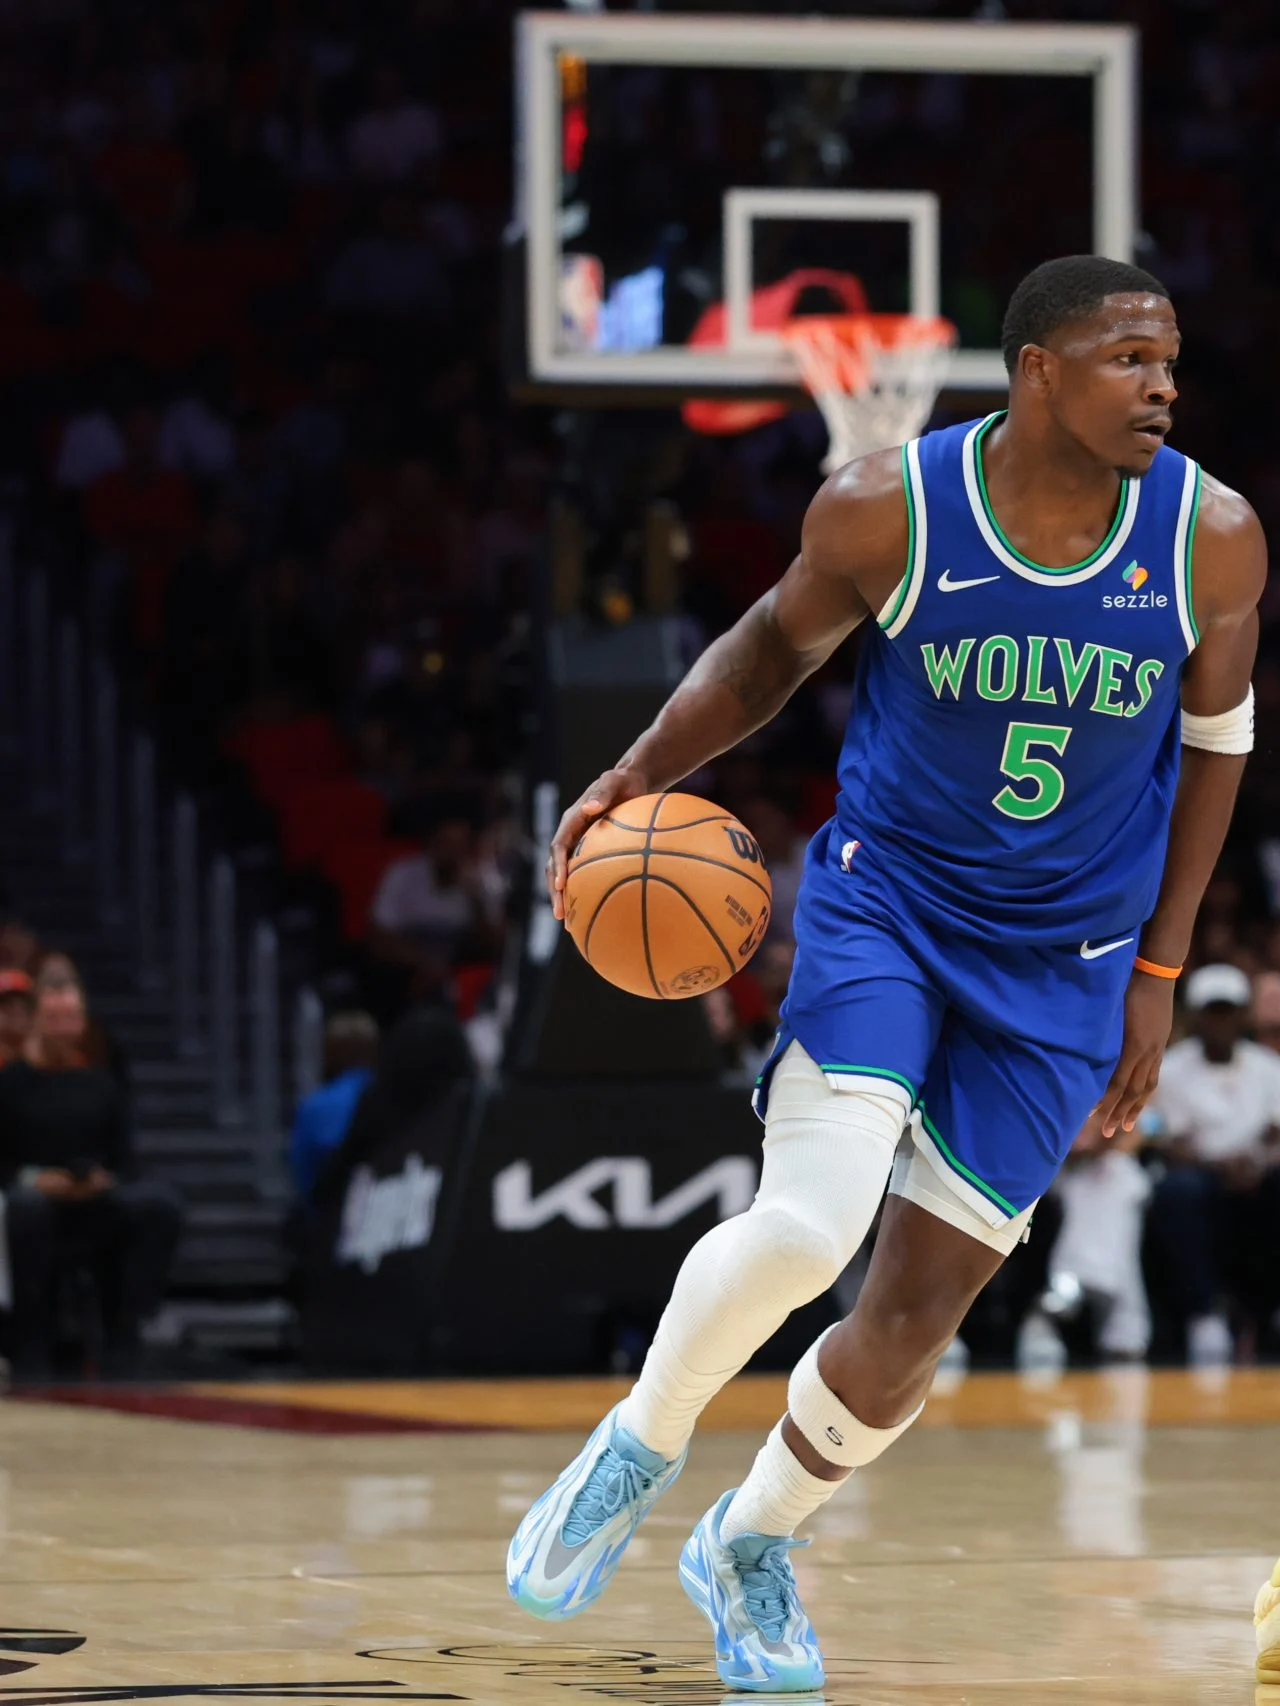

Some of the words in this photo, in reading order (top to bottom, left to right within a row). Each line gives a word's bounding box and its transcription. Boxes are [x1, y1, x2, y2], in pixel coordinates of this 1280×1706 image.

[1102, 590, 1168, 608] sezzle
[920, 634, 1165, 718] WOLVES
[992, 721, 1073, 821] 5
